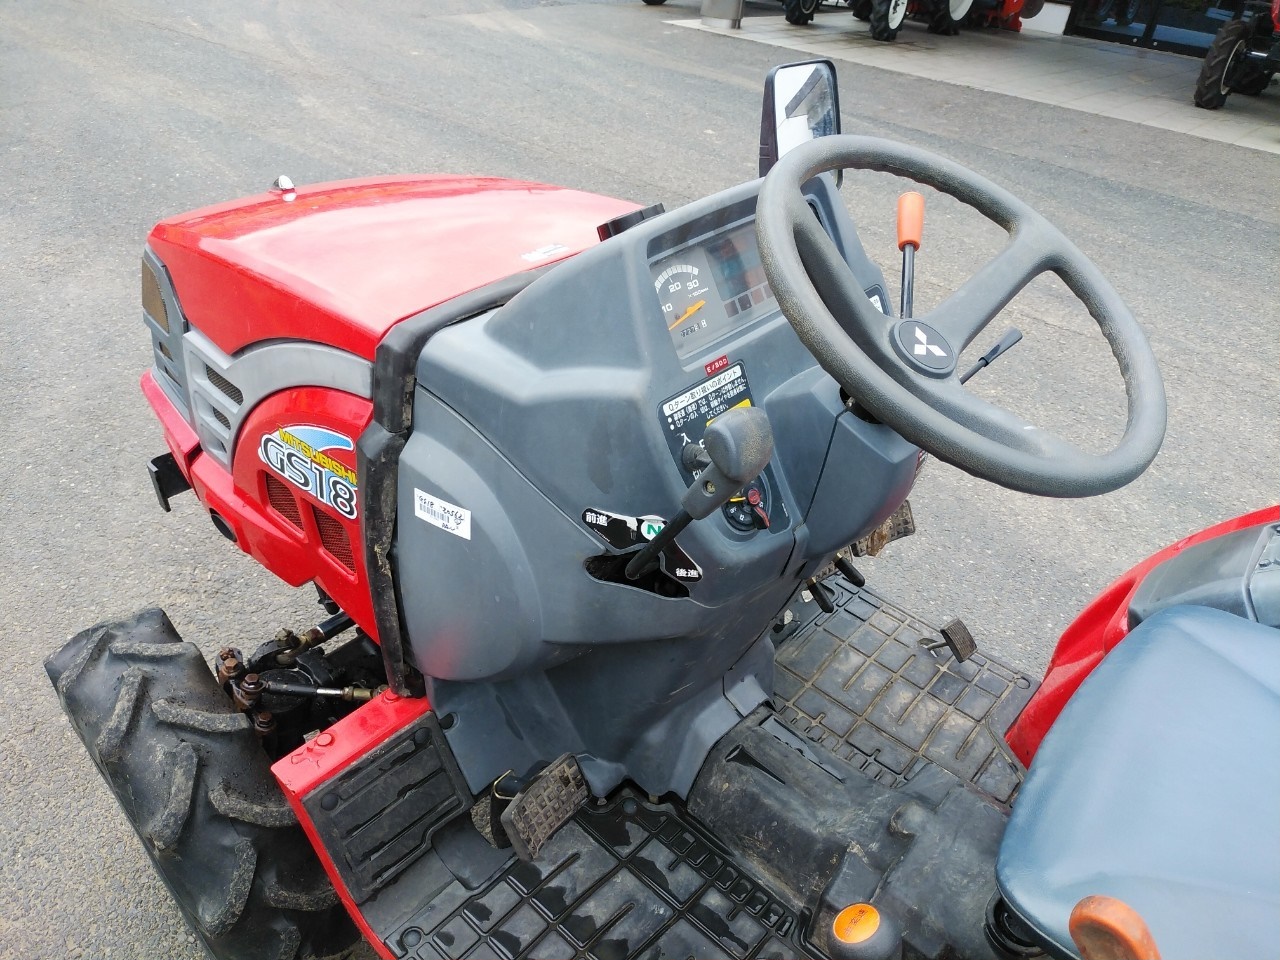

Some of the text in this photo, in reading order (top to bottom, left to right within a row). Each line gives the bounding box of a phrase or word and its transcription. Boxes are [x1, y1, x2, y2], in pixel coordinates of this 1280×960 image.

[668, 281, 682, 292] 20
[686, 278, 699, 290] 30
[680, 433, 691, 445] 入
[278, 428, 357, 486] MITSUBISHI
[261, 434, 357, 519] GS18
[586, 511, 608, 526] 前進
[646, 524, 662, 536] N
[675, 568, 699, 578] 後進
